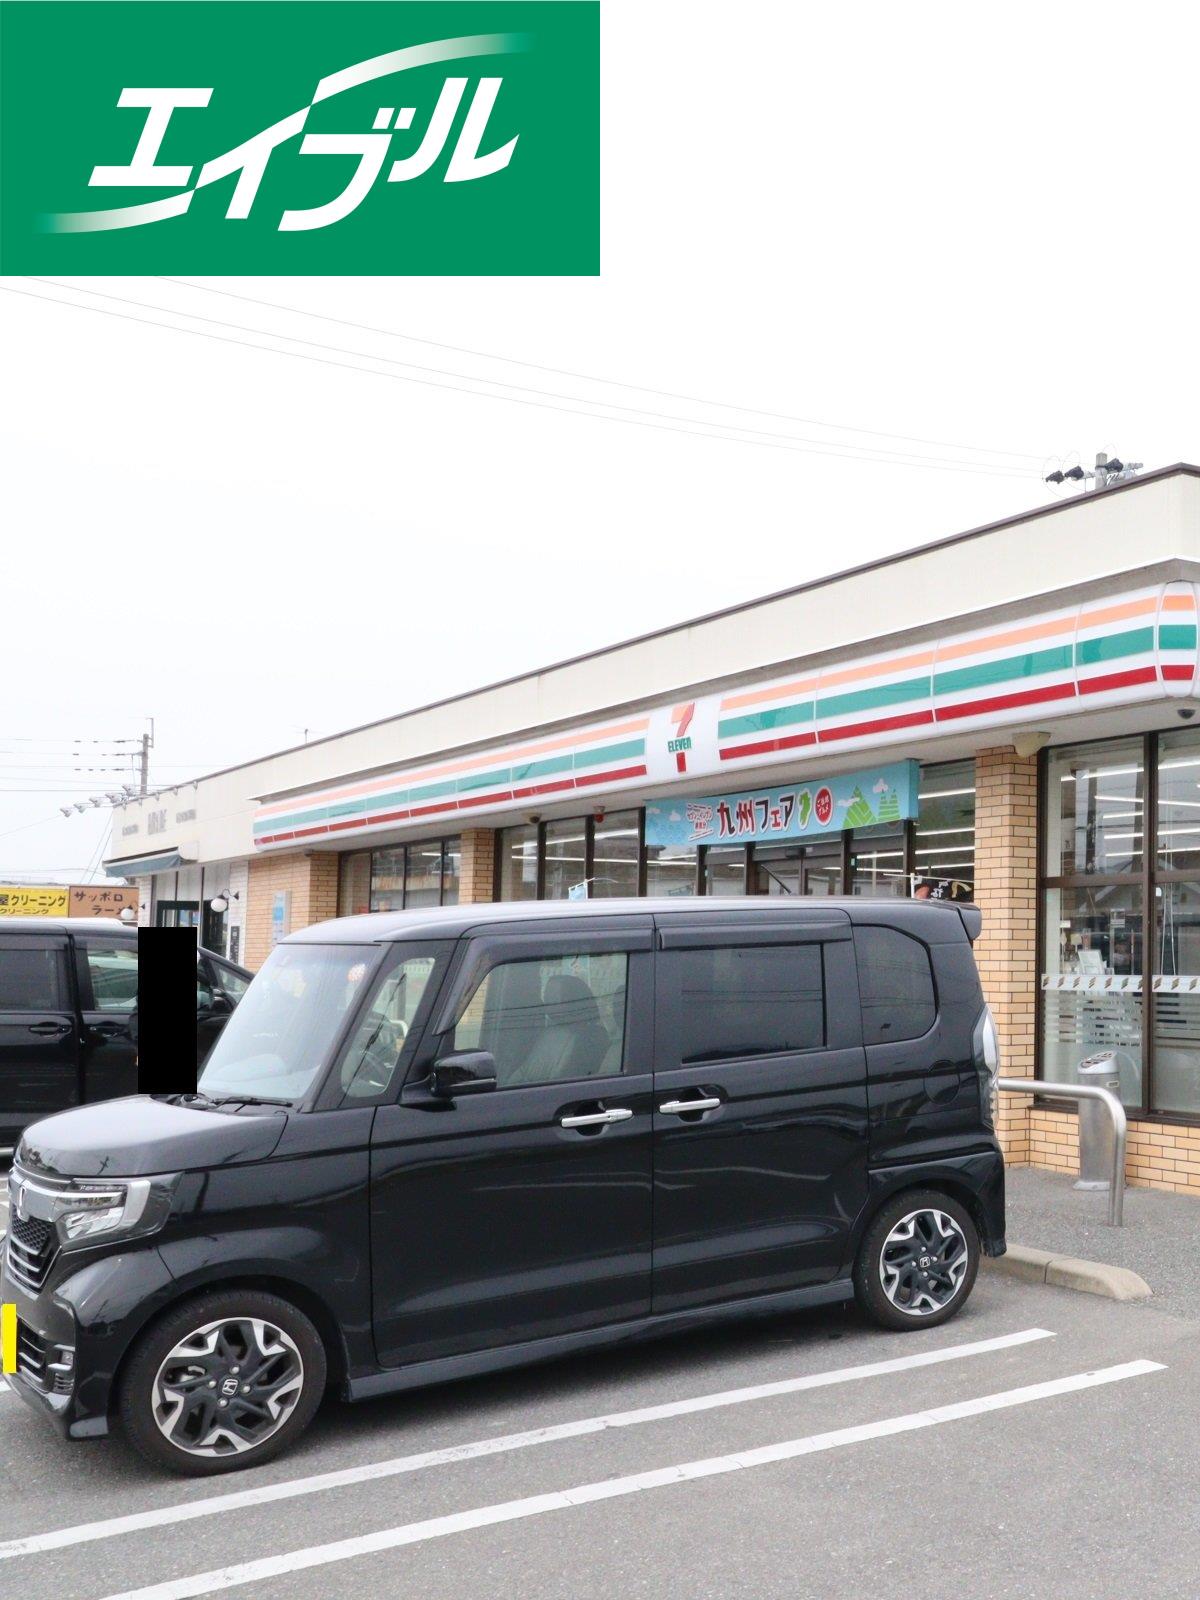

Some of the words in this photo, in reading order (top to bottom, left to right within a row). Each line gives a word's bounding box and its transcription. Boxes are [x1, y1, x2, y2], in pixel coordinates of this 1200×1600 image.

[717, 793, 795, 836] 九州フェア
[74, 890, 123, 902] サッポロ
